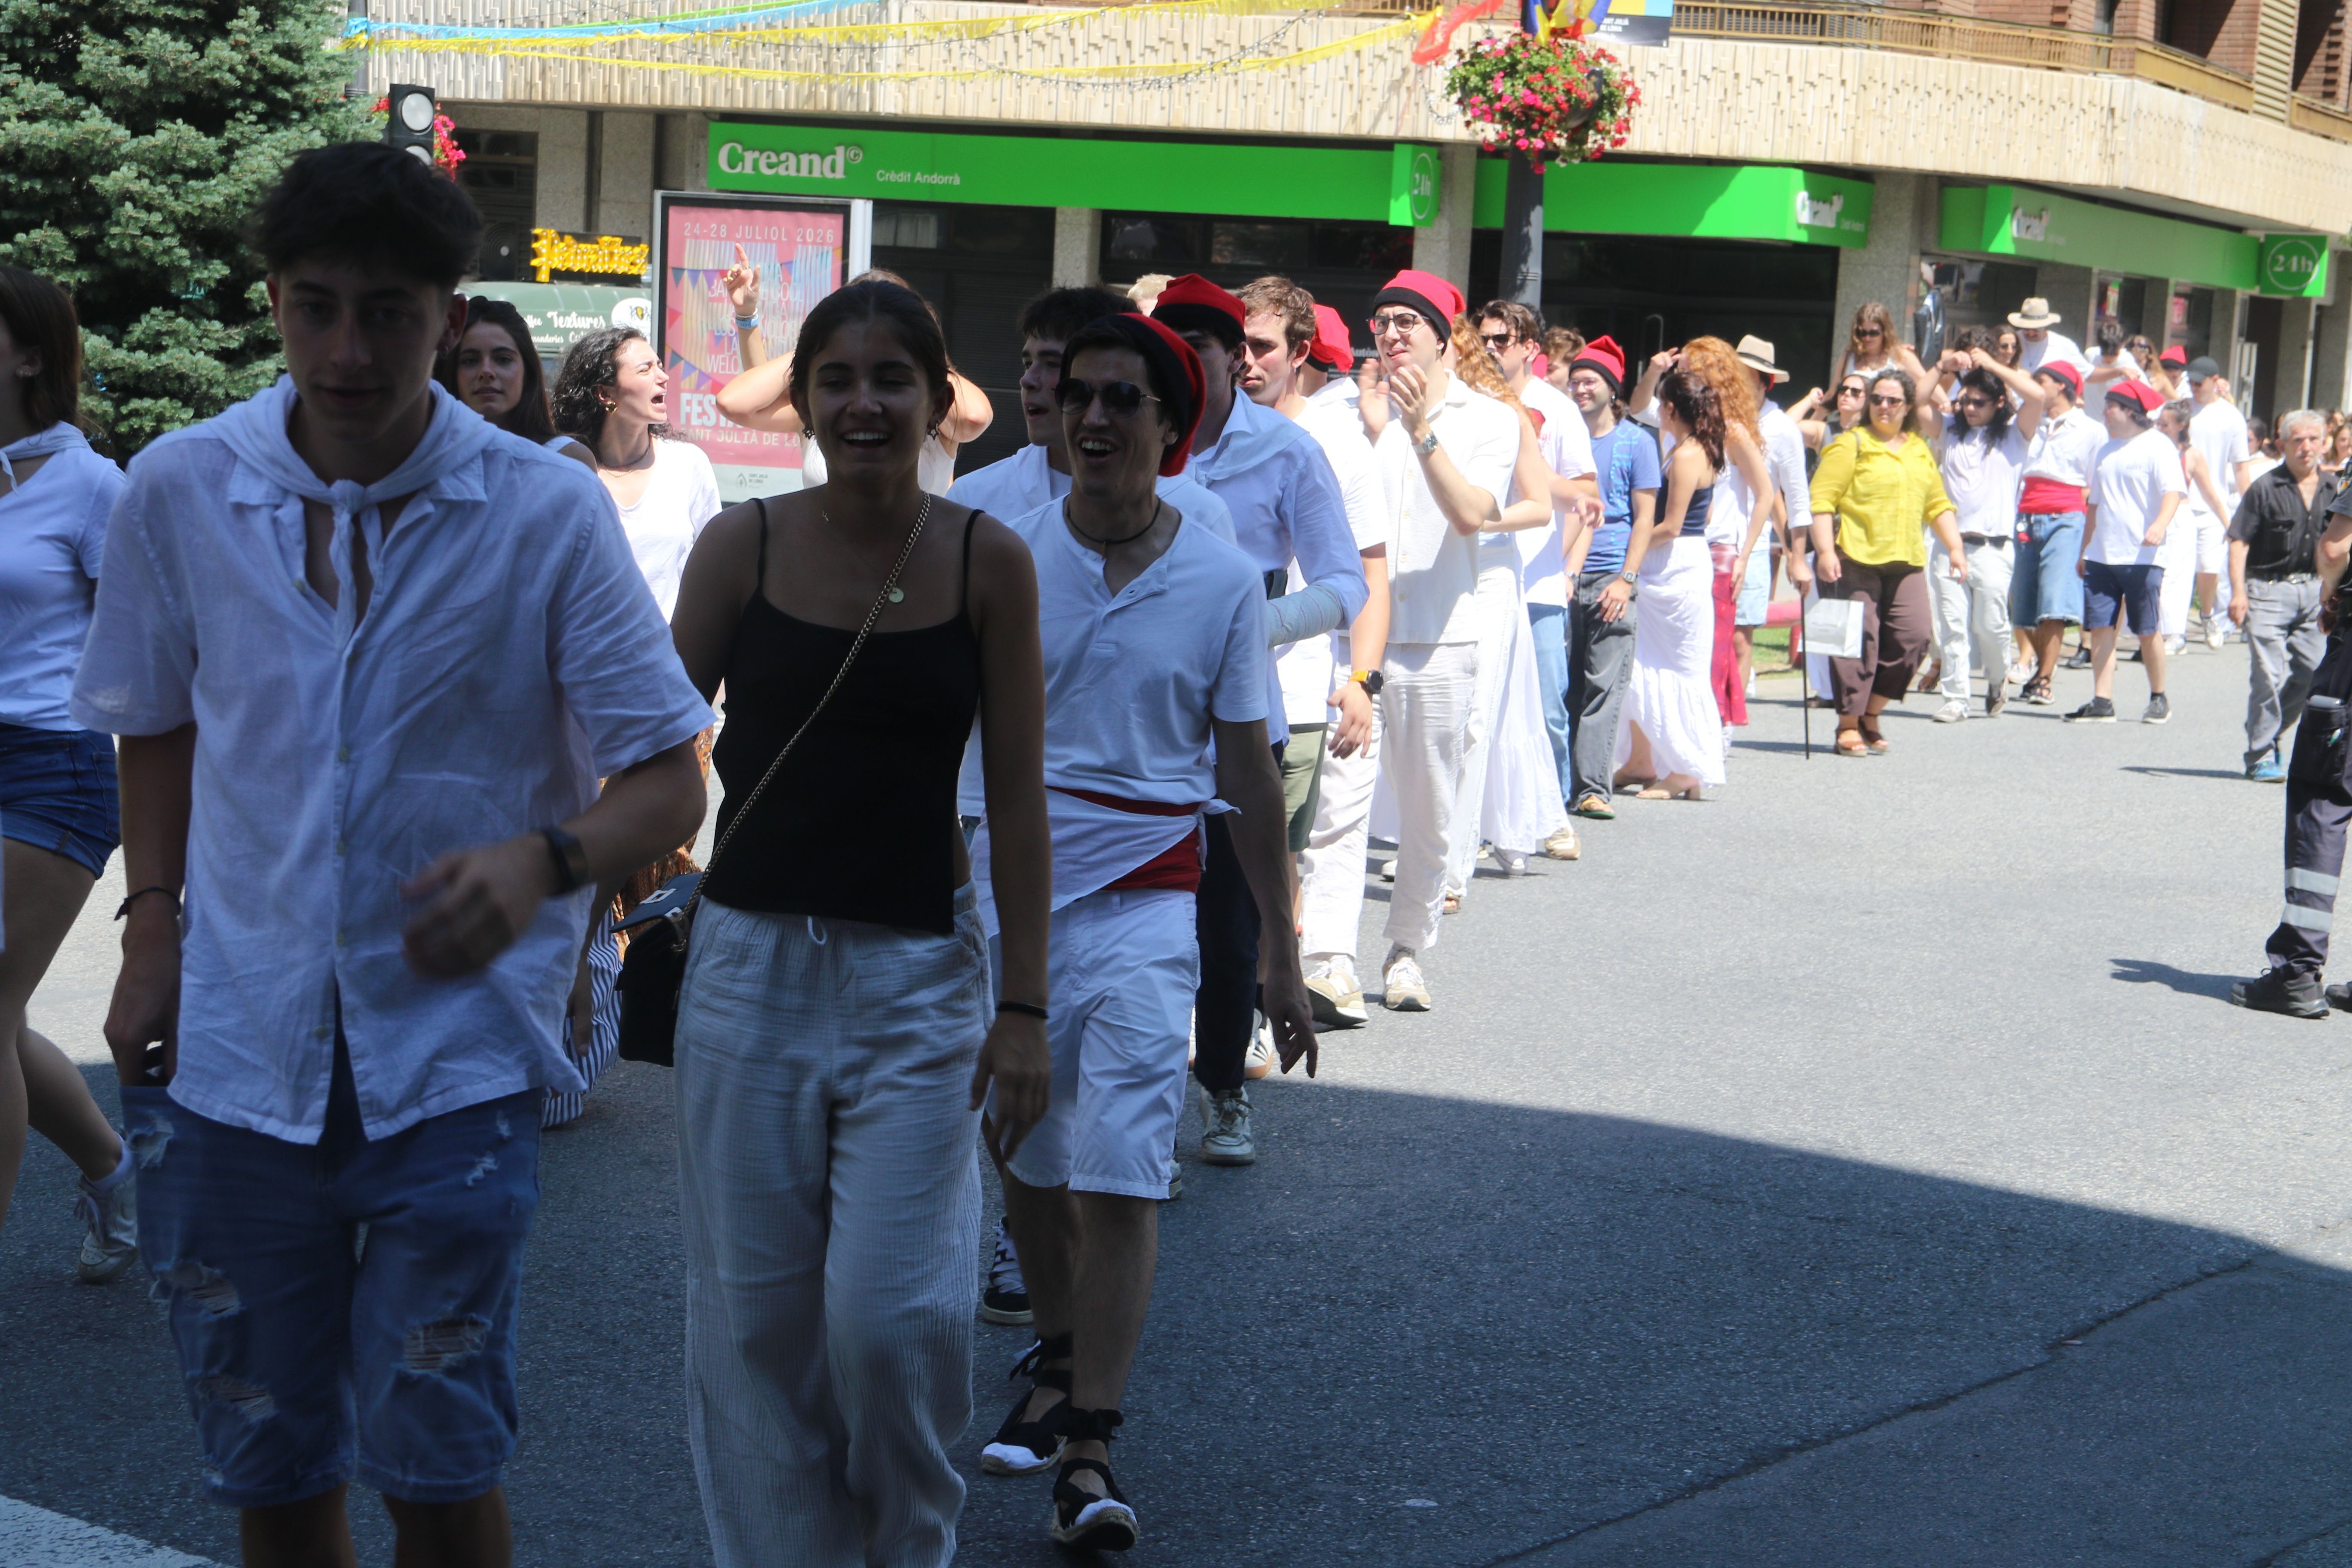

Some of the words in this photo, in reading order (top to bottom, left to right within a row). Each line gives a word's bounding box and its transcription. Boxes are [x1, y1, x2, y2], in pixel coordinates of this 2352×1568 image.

[876, 169, 911, 183] Crèdit
[914, 171, 961, 185] Andorrà
[1412, 173, 1431, 196] 24h
[684, 222, 728, 238] 24-28
[735, 225, 788, 241] JULIOL
[796, 228, 834, 243] 2026
[2272, 254, 2313, 273] 24h
[547, 311, 606, 329] Textures
[717, 429, 758, 444] JULIÀ
[763, 433, 779, 446] DE
